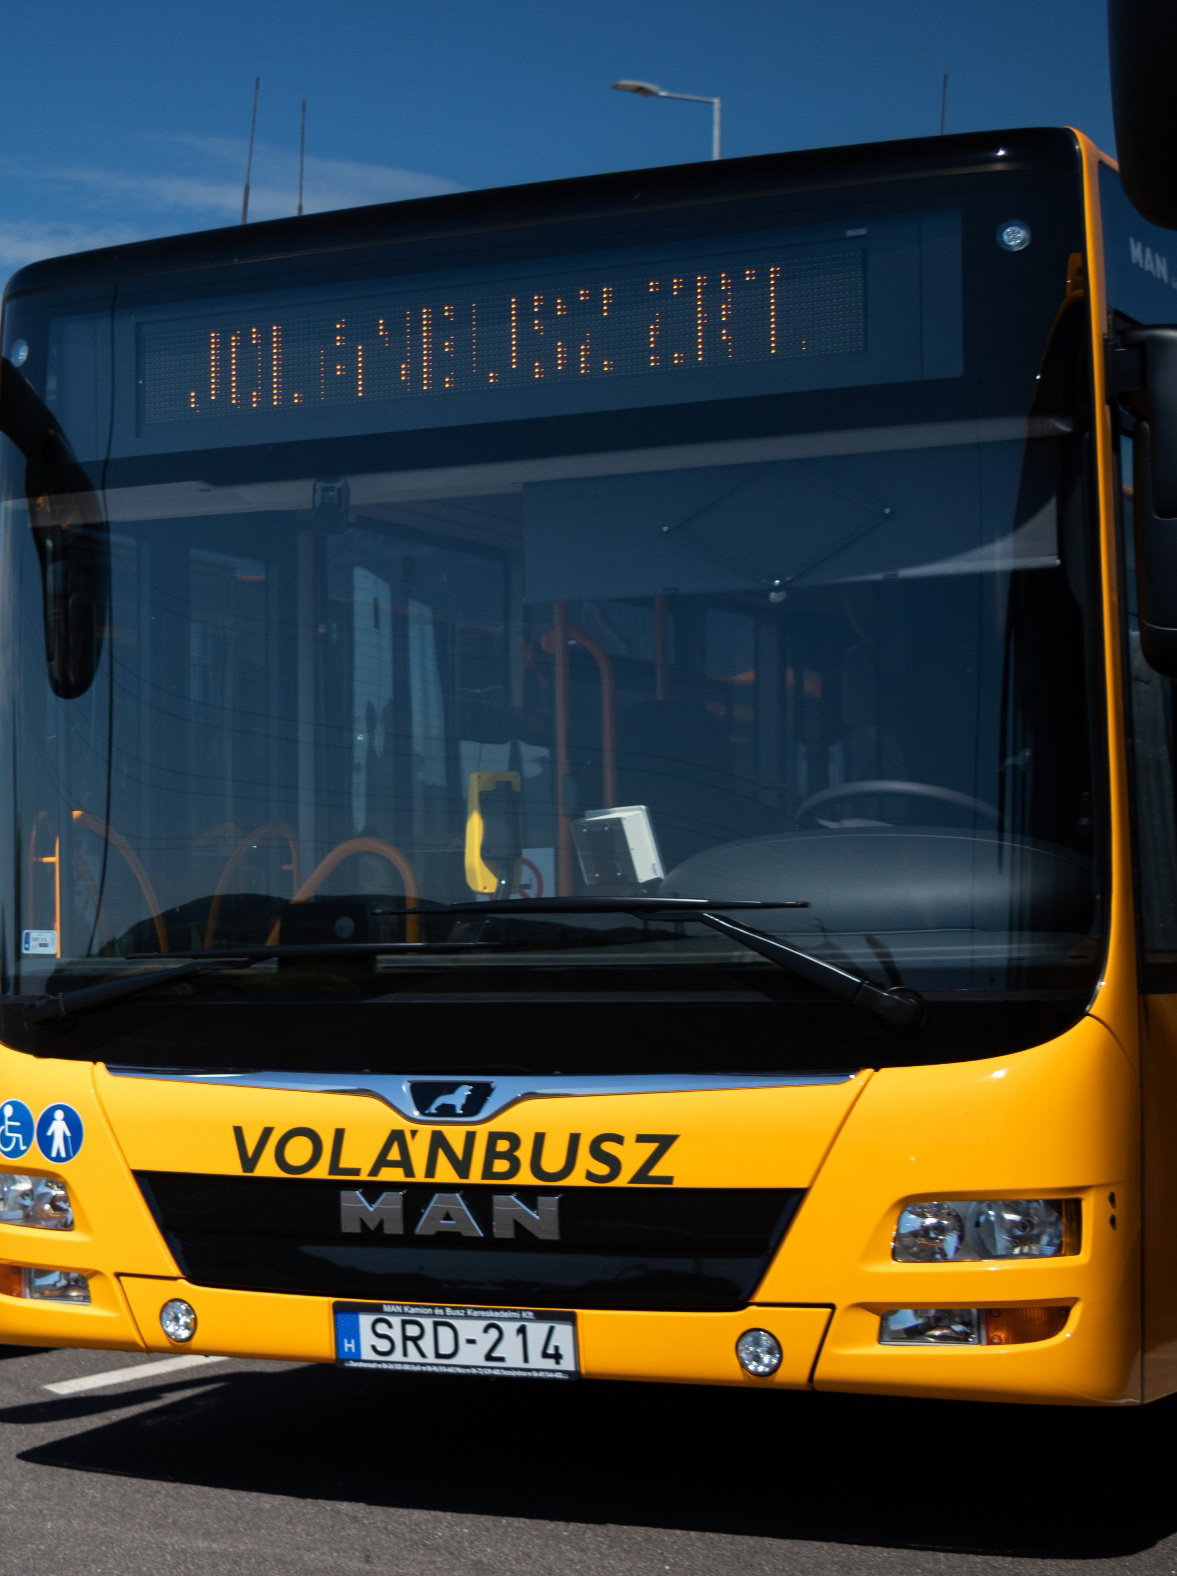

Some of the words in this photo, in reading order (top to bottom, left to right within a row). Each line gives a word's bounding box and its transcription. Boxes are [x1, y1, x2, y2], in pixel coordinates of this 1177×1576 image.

[1129, 237, 1169, 284] MAN
[232, 1125, 681, 1186] VOLÁNBUSZ
[339, 1189, 562, 1240] MAN
[343, 1338, 356, 1353] H
[370, 1316, 564, 1366] SRD-214
